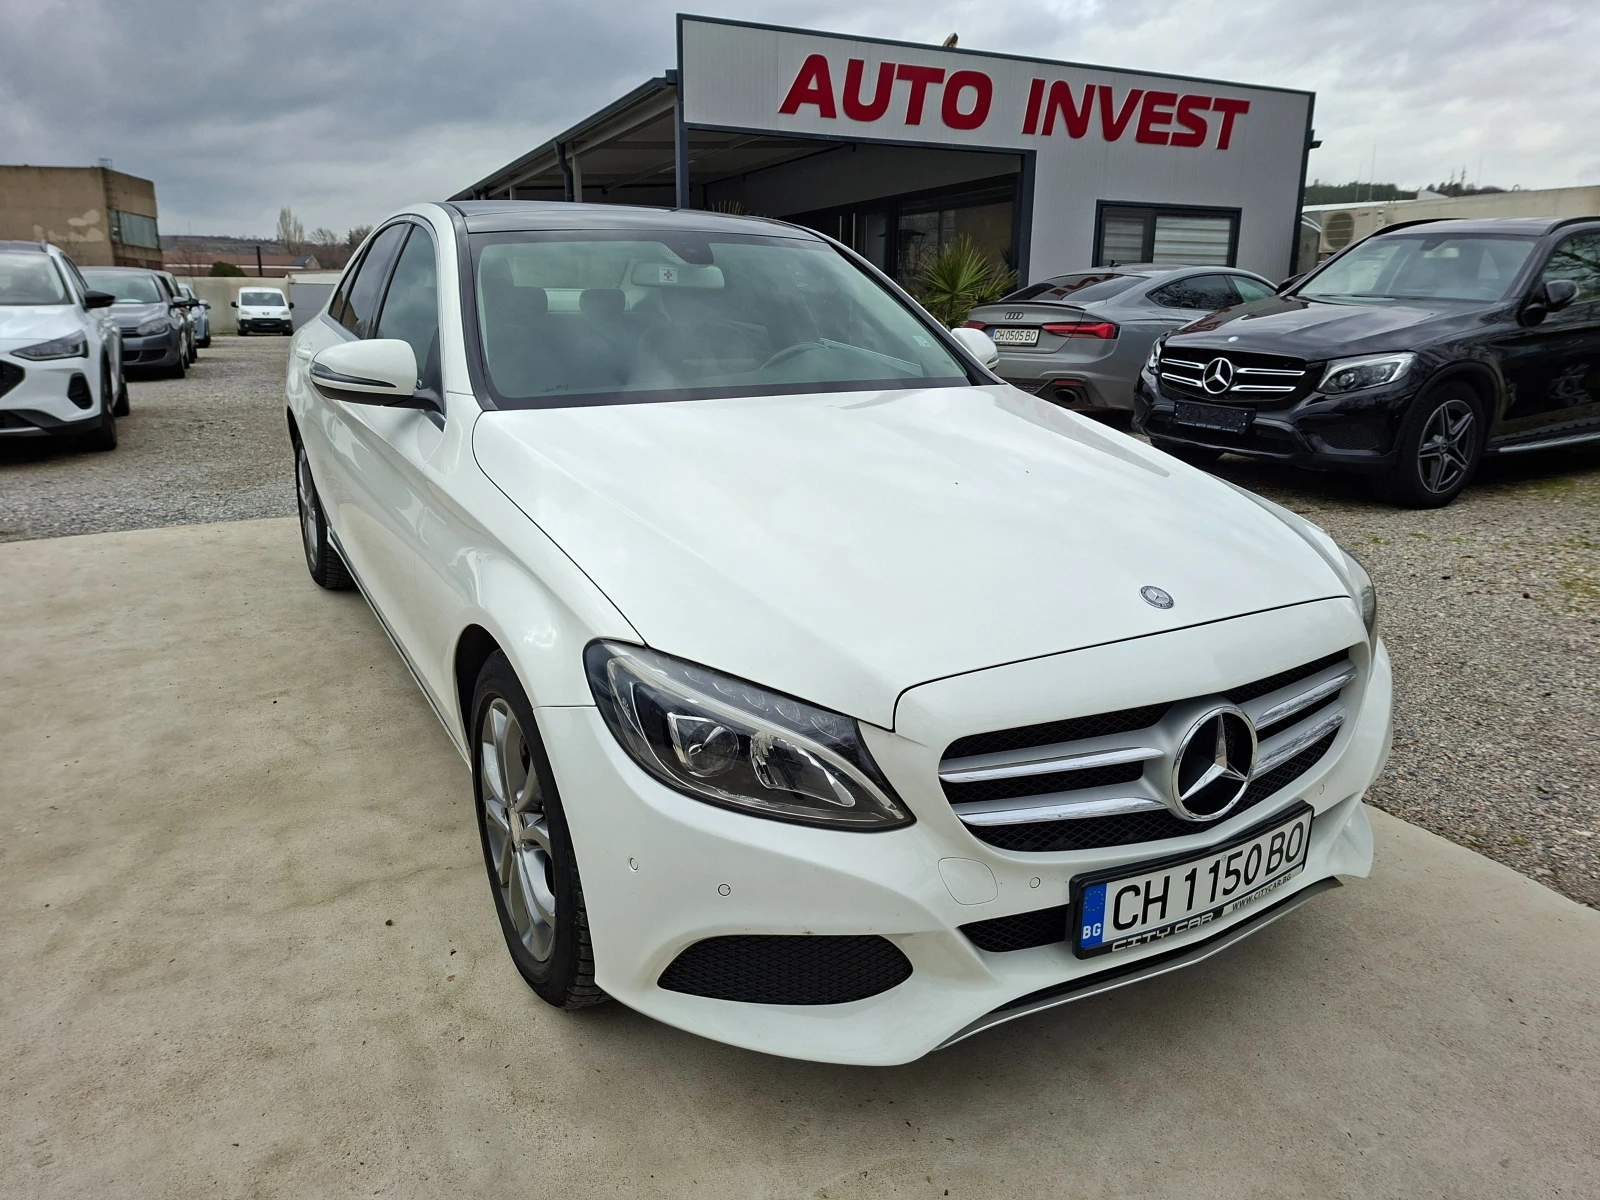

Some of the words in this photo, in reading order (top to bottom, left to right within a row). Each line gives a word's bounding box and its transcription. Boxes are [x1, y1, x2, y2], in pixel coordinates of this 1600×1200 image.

[778, 54, 993, 130] AUTO
[1021, 77, 1251, 151] INVEST
[995, 330, 1005, 340] CH
[1005, 331, 1025, 341] 0505
[1025, 331, 1036, 341] BO
[1112, 875, 1171, 931] CH
[1184, 843, 1262, 911] 1150
[1265, 821, 1304, 876] BO
[1232, 873, 1292, 912] WWW.CITYCAR.BG
[1082, 923, 1102, 940] BG
[1112, 927, 1171, 952] CITY
[1173, 912, 1214, 934] CAR
